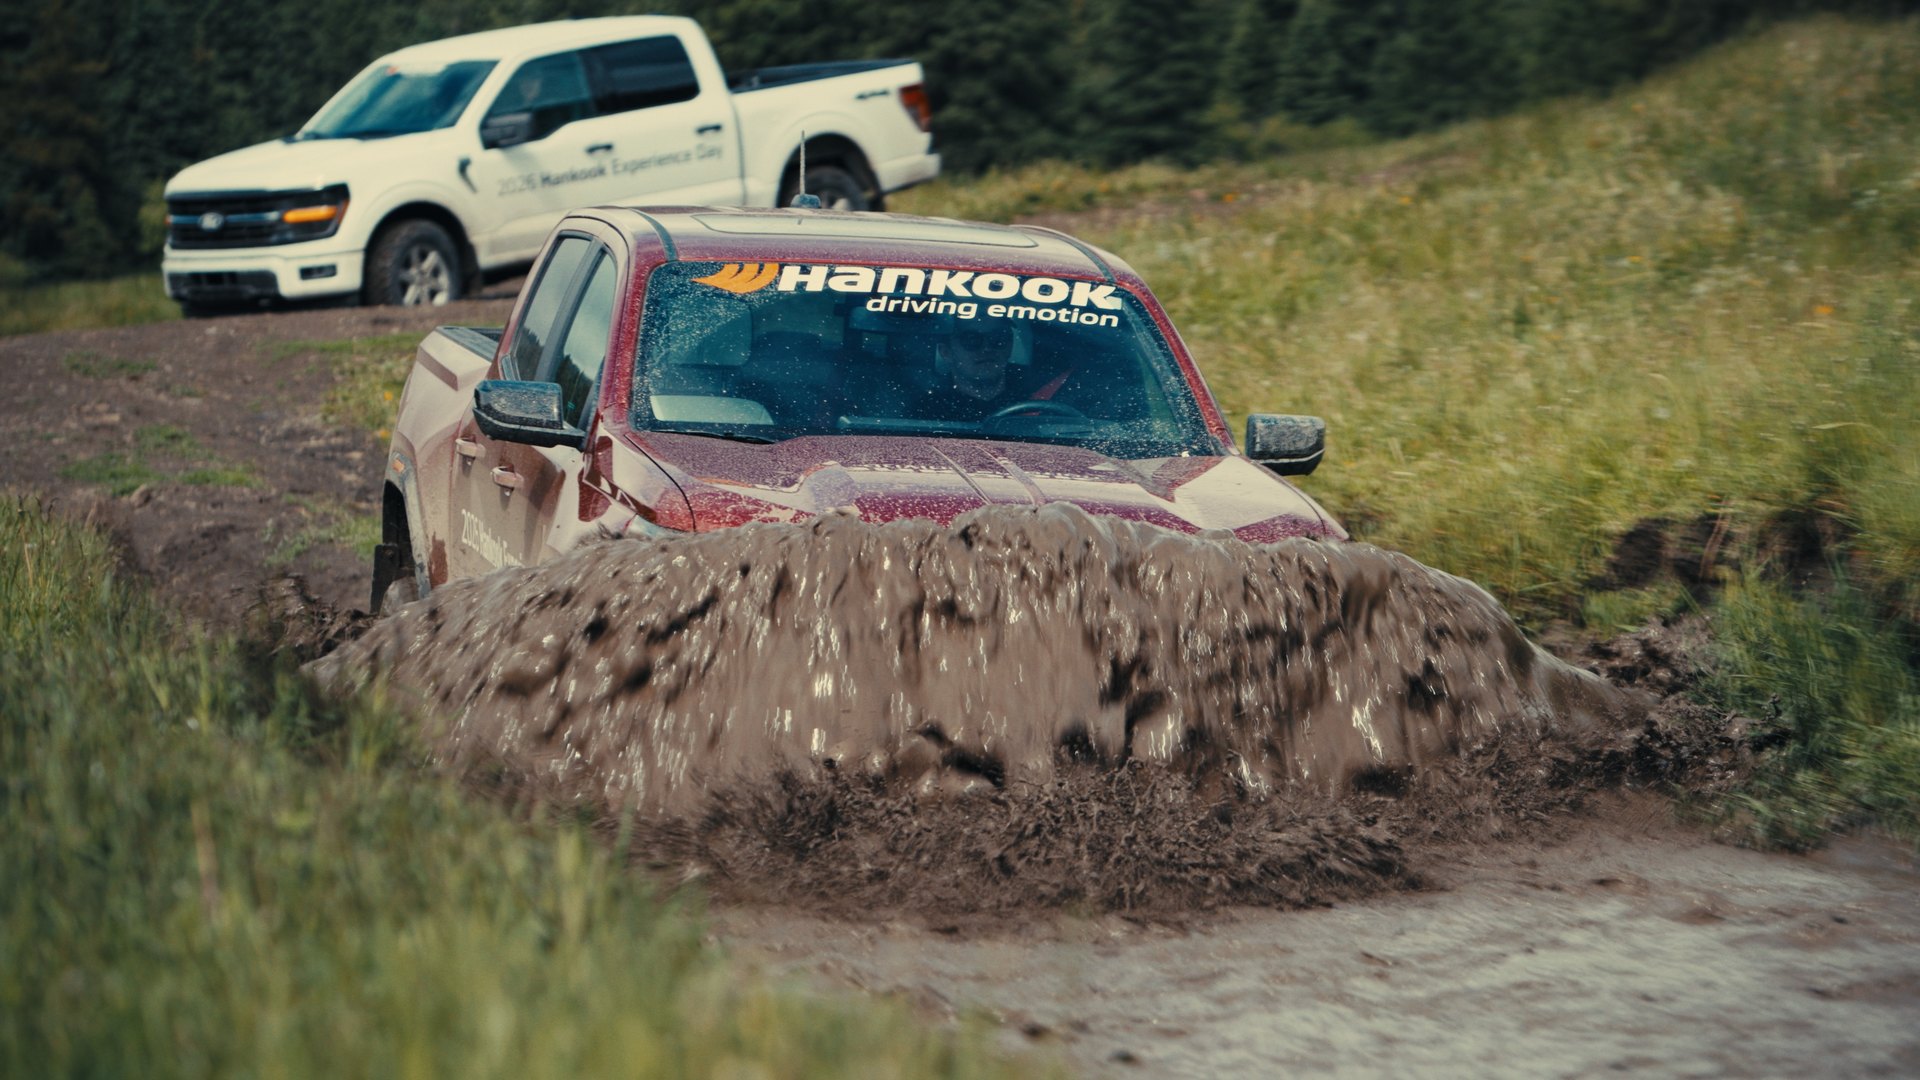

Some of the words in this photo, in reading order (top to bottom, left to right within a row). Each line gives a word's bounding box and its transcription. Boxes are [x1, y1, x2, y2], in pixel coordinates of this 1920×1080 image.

[540, 165, 606, 188] Hankook
[612, 150, 692, 175] Experience
[695, 144, 723, 161] Day
[866, 295, 977, 320] driving
[987, 302, 1120, 328] emotion
